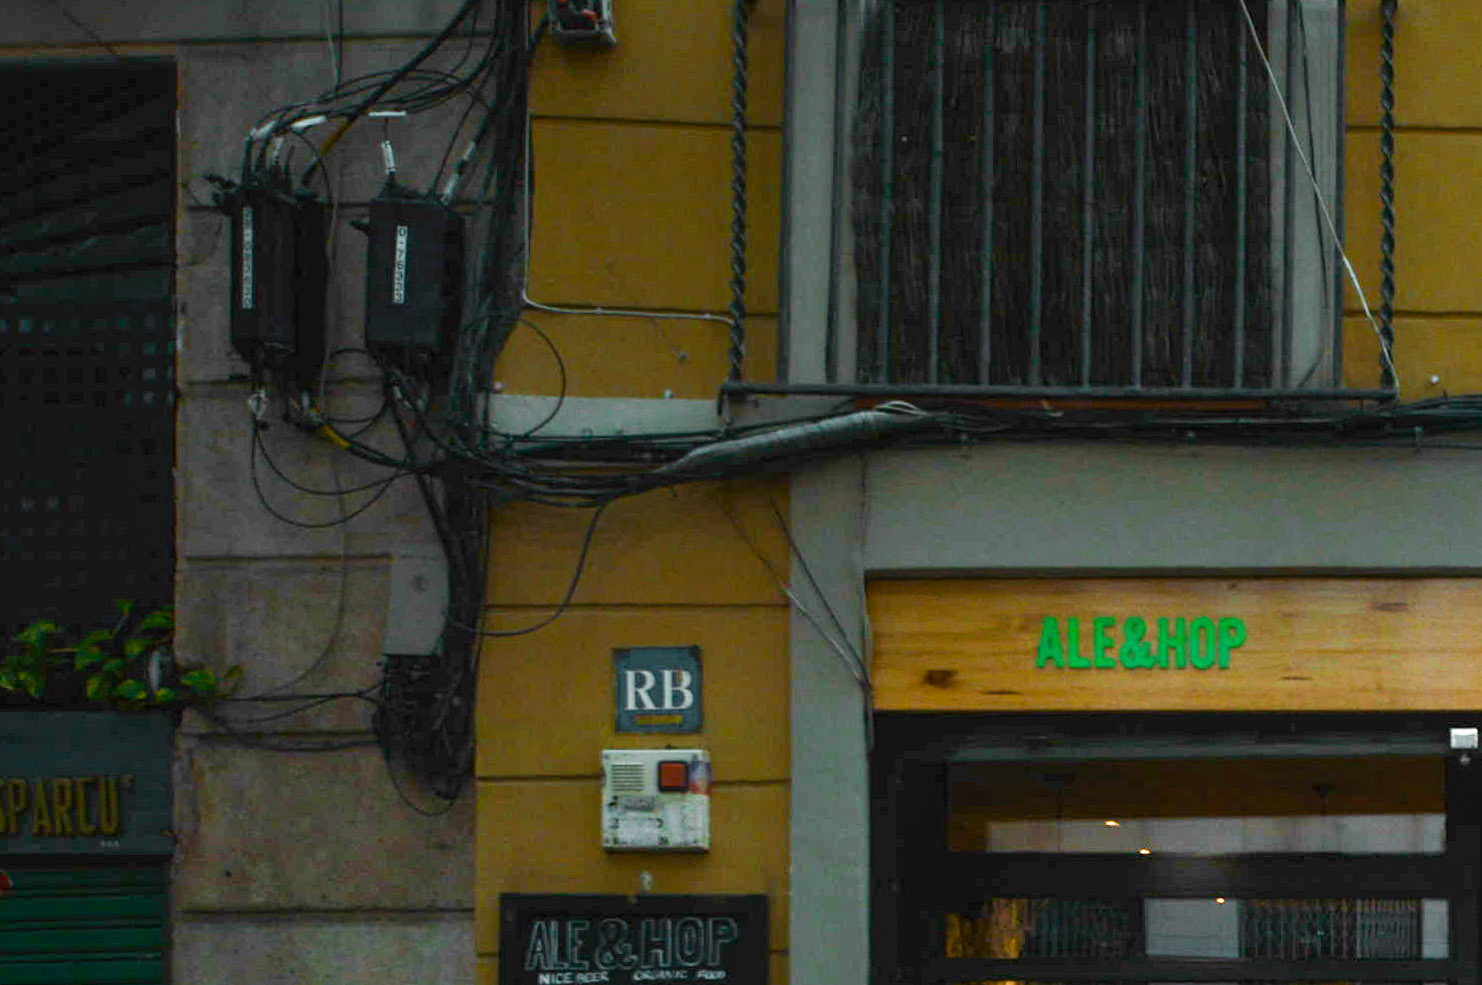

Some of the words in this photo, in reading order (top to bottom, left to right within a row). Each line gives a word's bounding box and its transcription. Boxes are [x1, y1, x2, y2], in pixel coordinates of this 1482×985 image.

[1036, 616, 1247, 669] ALE&HOP
[624, 669, 694, 711] RB
[538, 972, 572, 985] NICE
[576, 971, 610, 984] BEER
